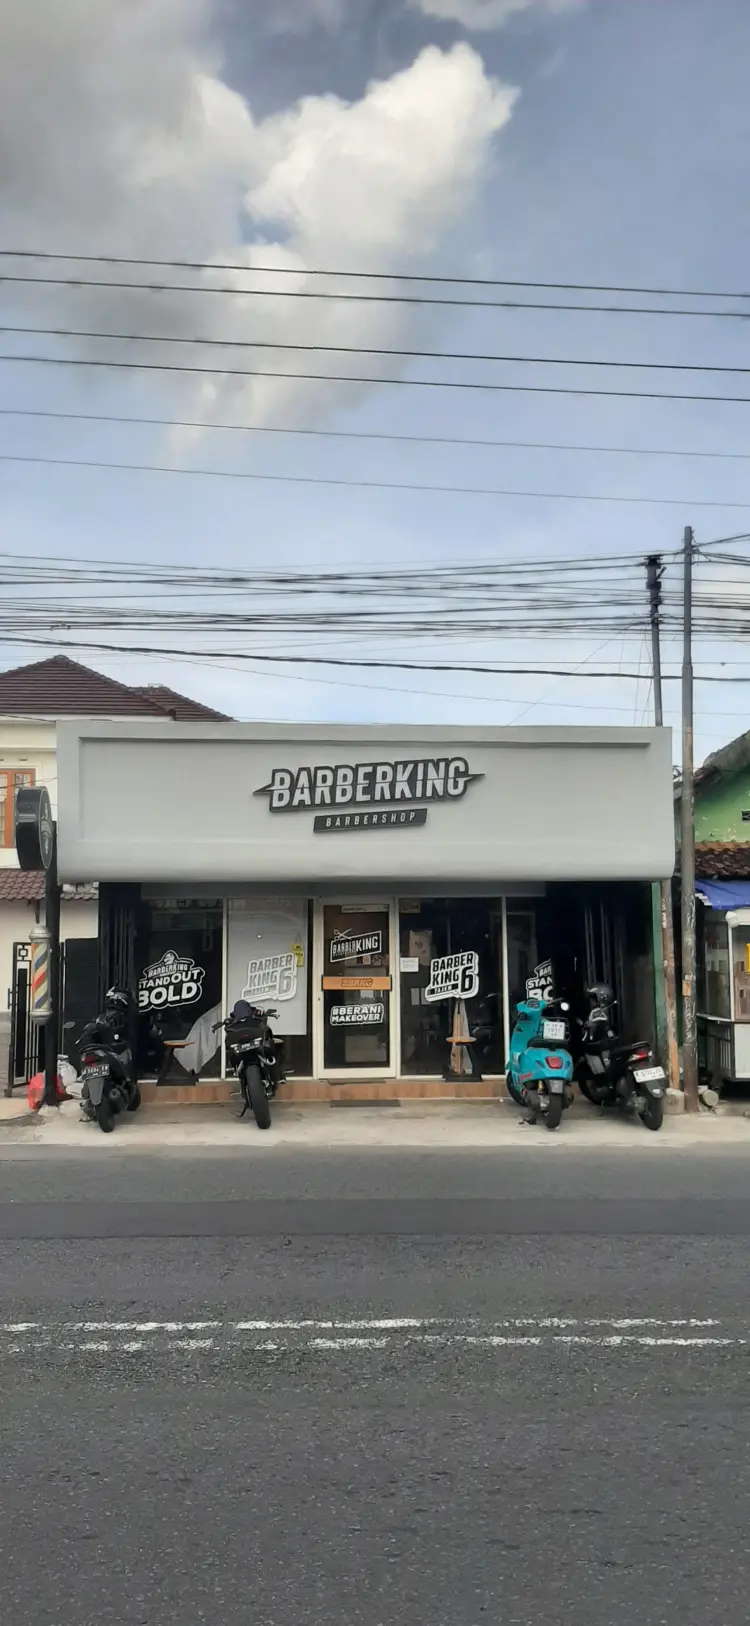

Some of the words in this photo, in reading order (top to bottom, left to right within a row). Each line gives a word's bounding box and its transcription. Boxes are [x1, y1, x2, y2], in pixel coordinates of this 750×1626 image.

[271, 759, 470, 807] BARBERKING
[325, 811, 416, 828] BARBERSHOP
[249, 954, 293, 974] BARBER
[432, 953, 473, 972] BARBER
[248, 970, 278, 989] KING
[278, 966, 293, 995] 6
[432, 969, 459, 987] KING
[460, 964, 474, 993] 6
[331, 1013, 380, 1023] MAKEOVER
[332, 1005, 381, 1015] #BERANI
